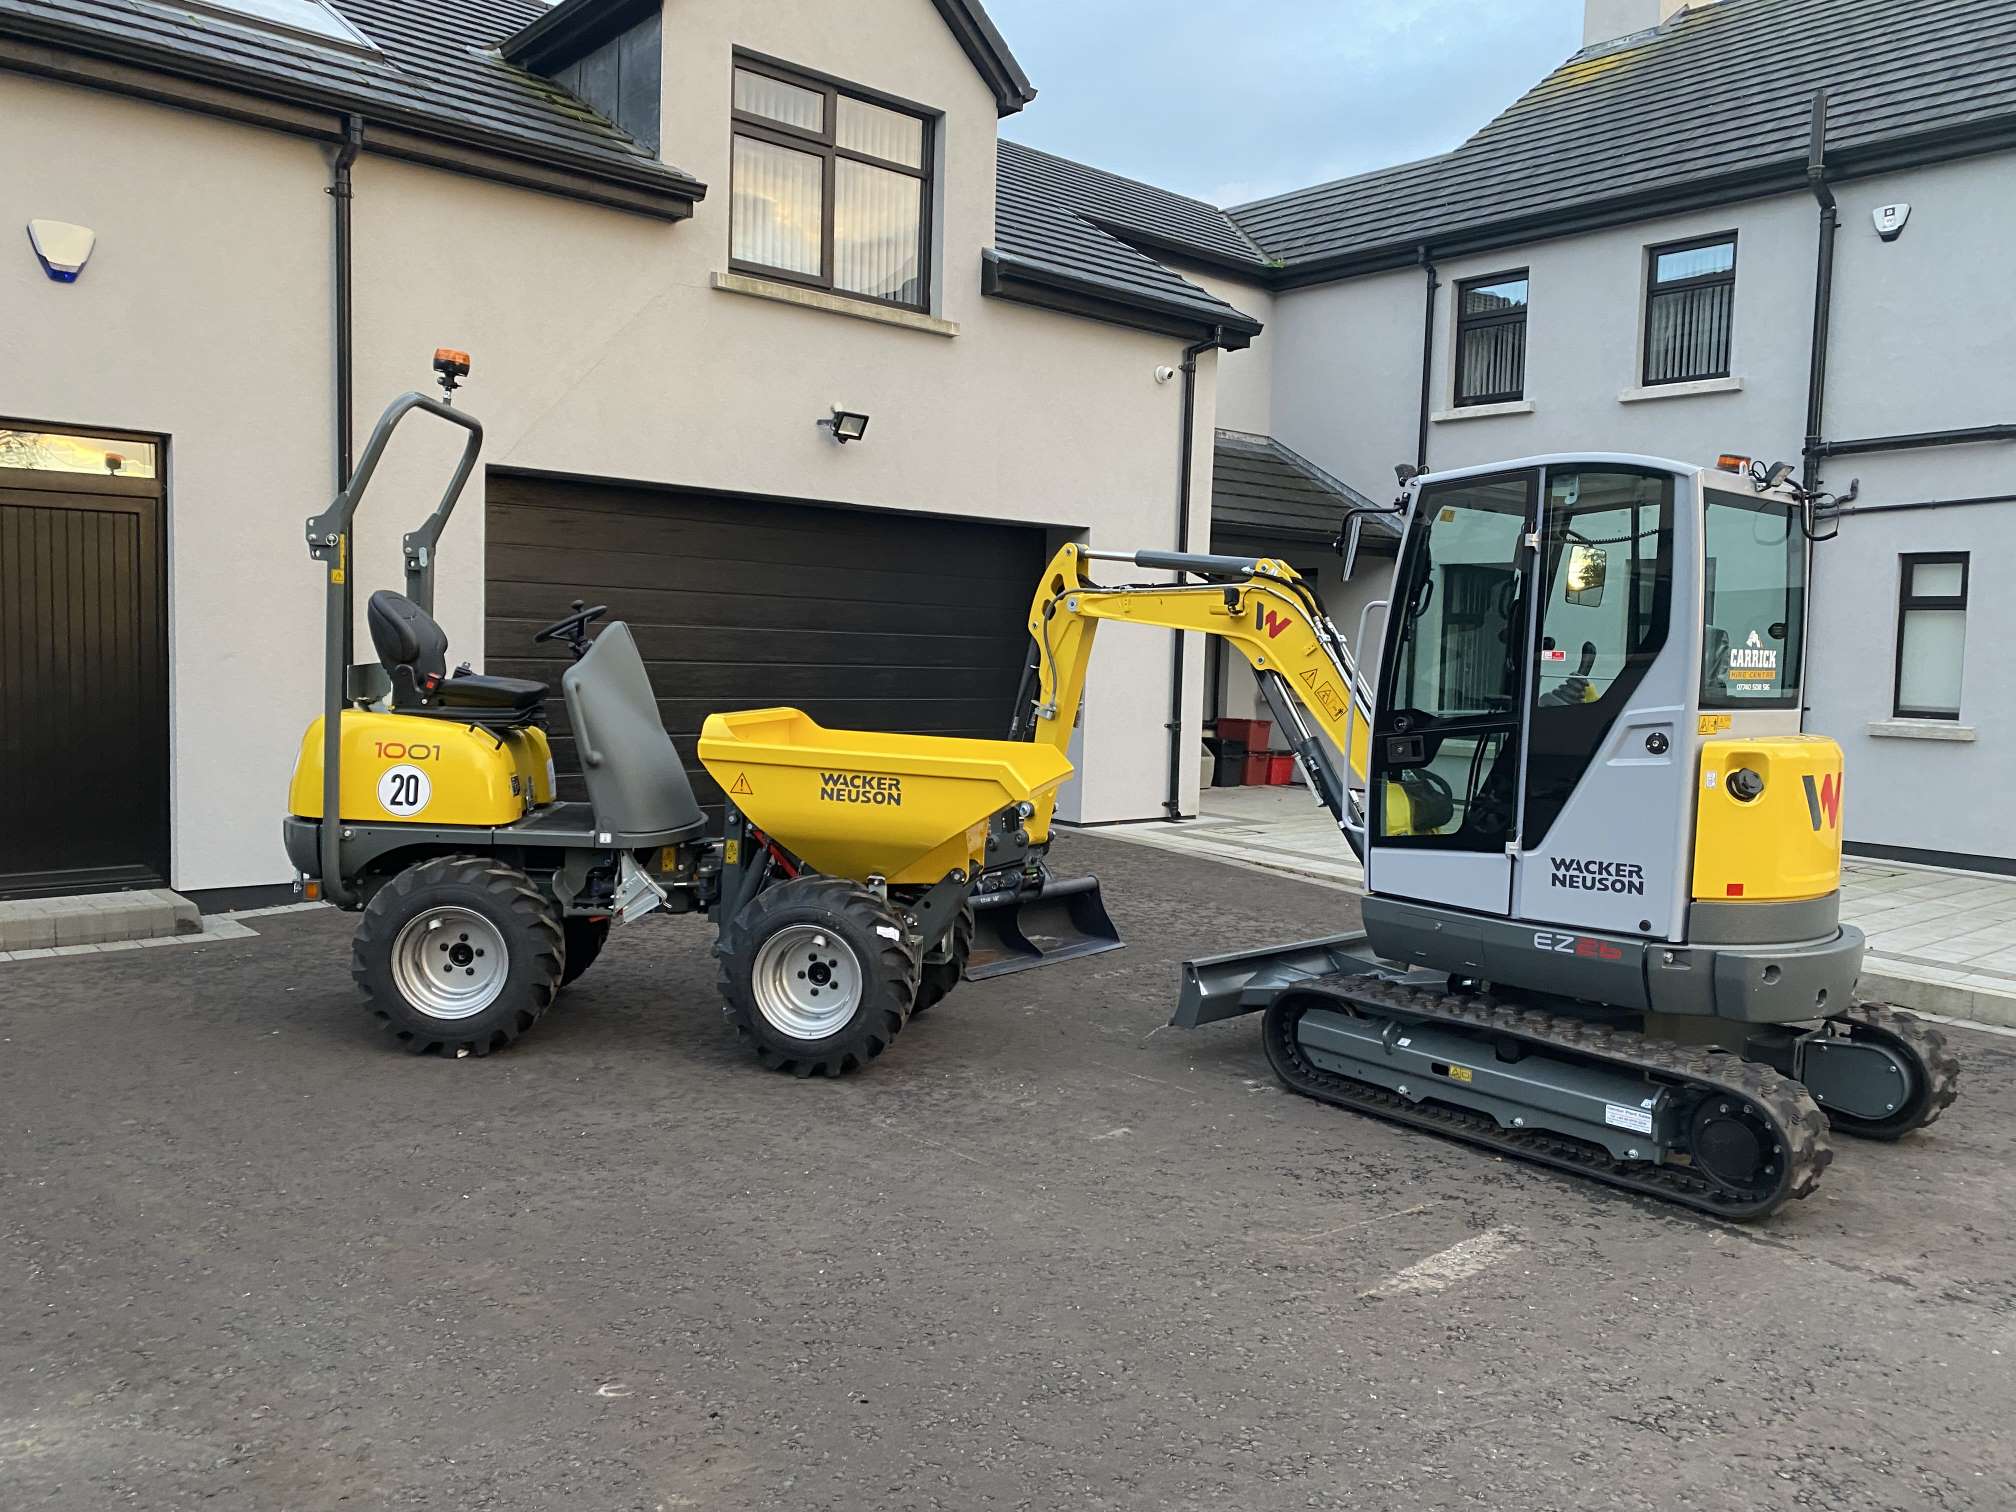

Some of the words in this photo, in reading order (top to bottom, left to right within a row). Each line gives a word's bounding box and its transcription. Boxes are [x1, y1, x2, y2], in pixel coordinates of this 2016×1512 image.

[1730, 648, 1777, 668] CARRICK
[375, 742, 441, 761] 1001
[390, 773, 420, 806] 20
[820, 772, 902, 792] WACKER
[820, 787, 902, 806] NEUSON
[1550, 857, 1644, 879] WACKER
[1551, 872, 1644, 895] NEUSON
